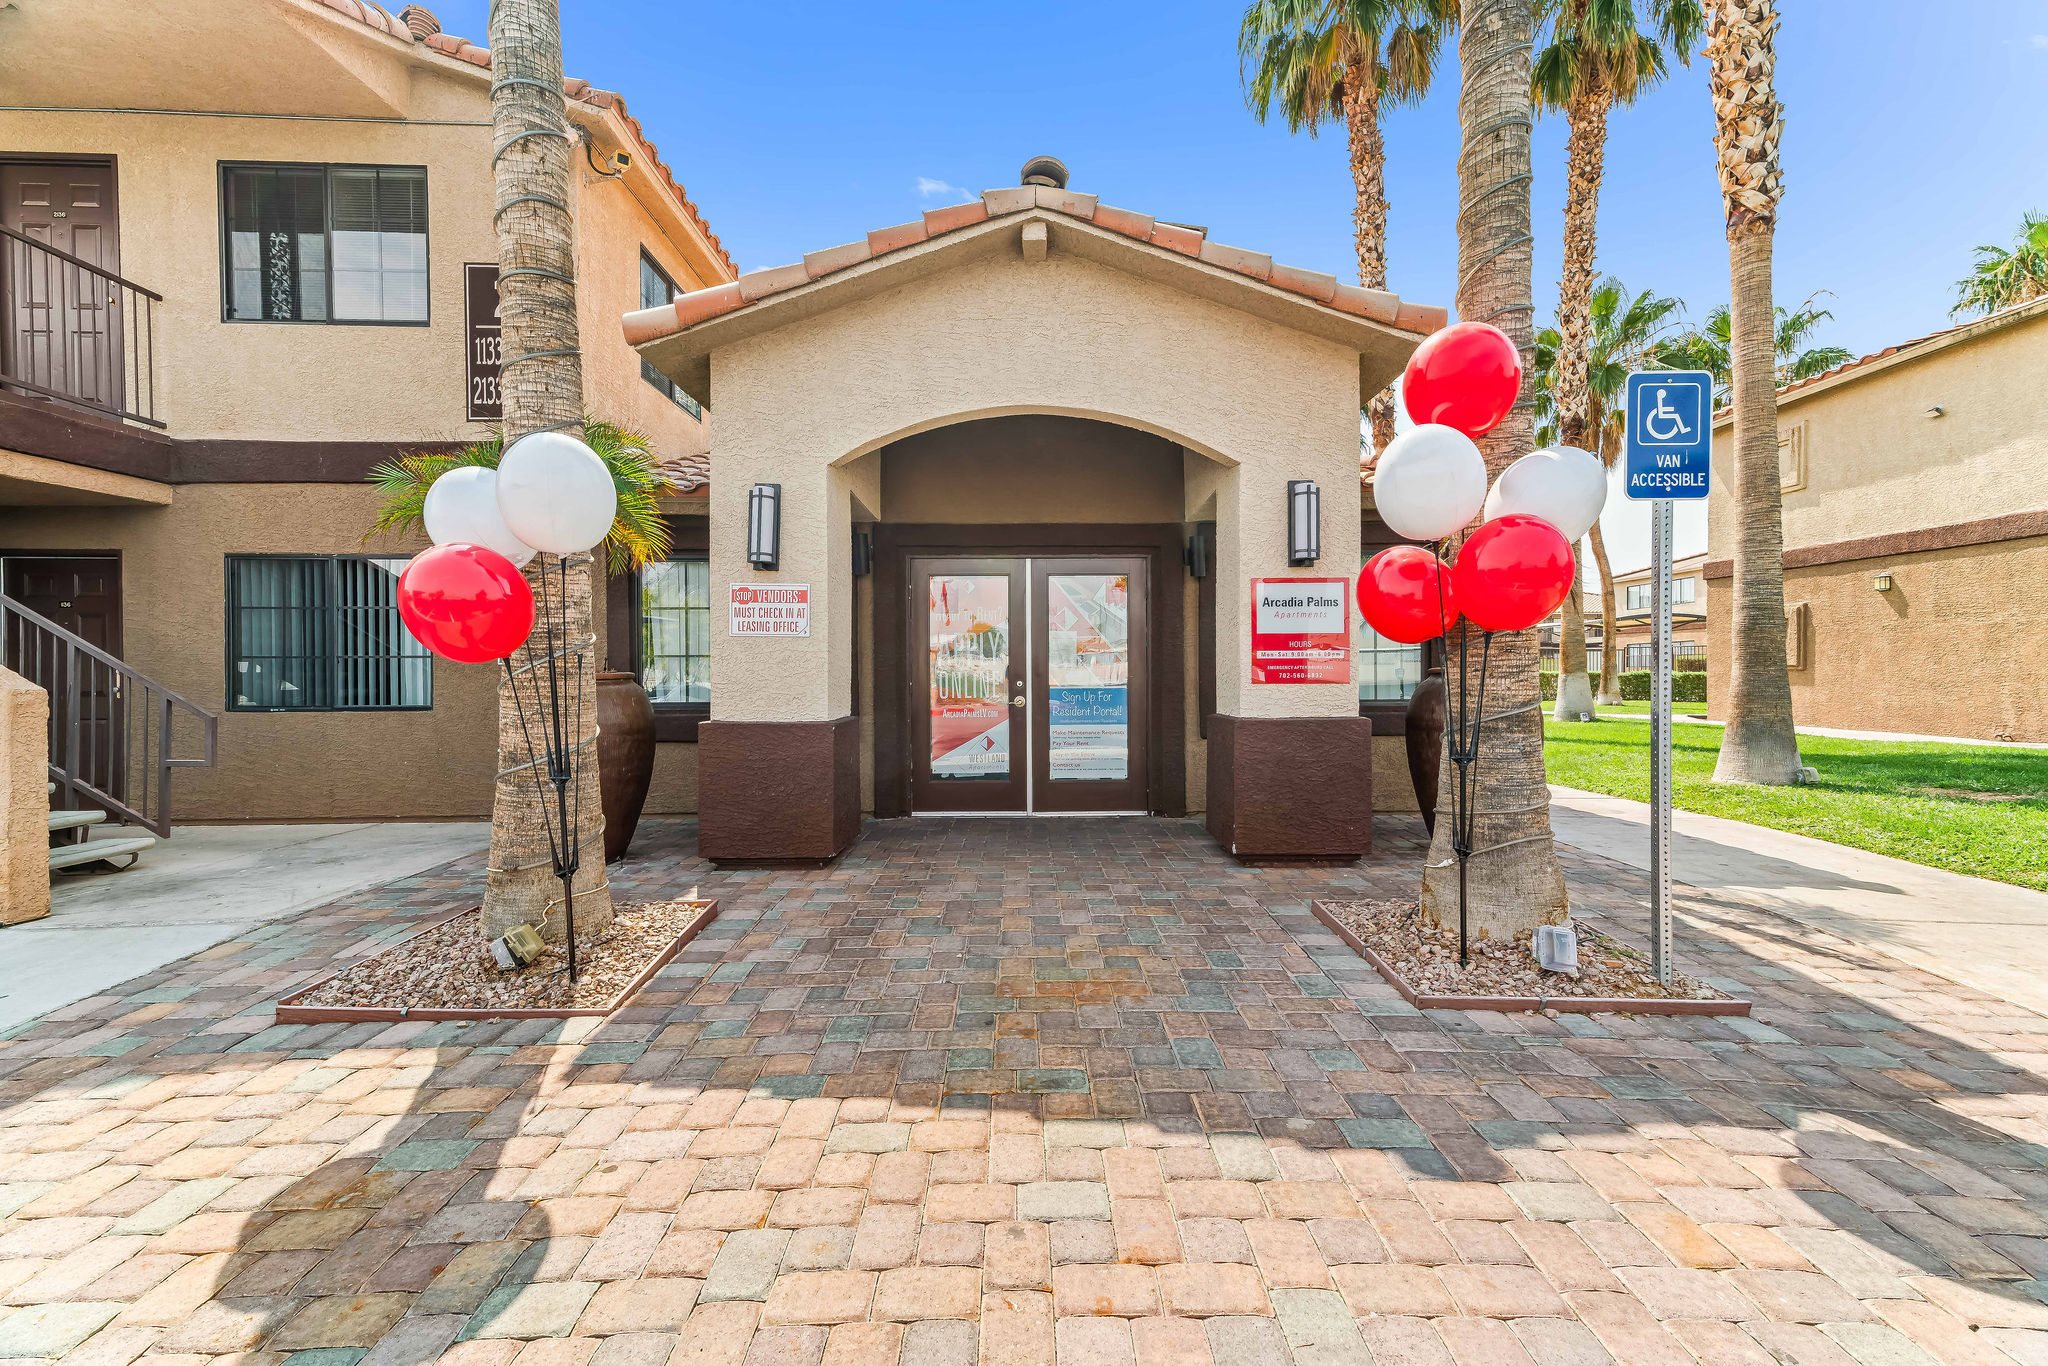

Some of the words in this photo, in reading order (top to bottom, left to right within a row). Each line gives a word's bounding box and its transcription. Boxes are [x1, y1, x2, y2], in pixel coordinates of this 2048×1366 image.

[475, 336, 502, 365] 1133
[473, 376, 502, 405] 2133
[1656, 454, 1681, 468] VAN
[1631, 472, 1706, 487] ACCESSIBLE
[736, 591, 752, 601] STOP
[757, 590, 802, 603] VENDORS:
[1262, 596, 1304, 608] Arcadia
[1306, 596, 1339, 607] Palms
[734, 607, 756, 619] MUST
[758, 607, 784, 619] CHECK
[785, 607, 794, 619] IN
[796, 607, 806, 619] AT
[1274, 611, 1327, 619] Apartments
[737, 620, 771, 633] LEASING
[773, 621, 799, 633] OFFICE
[1288, 640, 1312, 648] HOURS
[939, 671, 1000, 700] ONLINE
[1061, 691, 1081, 705] Sign
[1083, 691, 1096, 705] Up
[1098, 691, 1112, 702] For
[1052, 705, 1090, 717] Resident
[1093, 704, 1122, 717] Portal!
[968, 754, 1006, 763] WESTLAND
